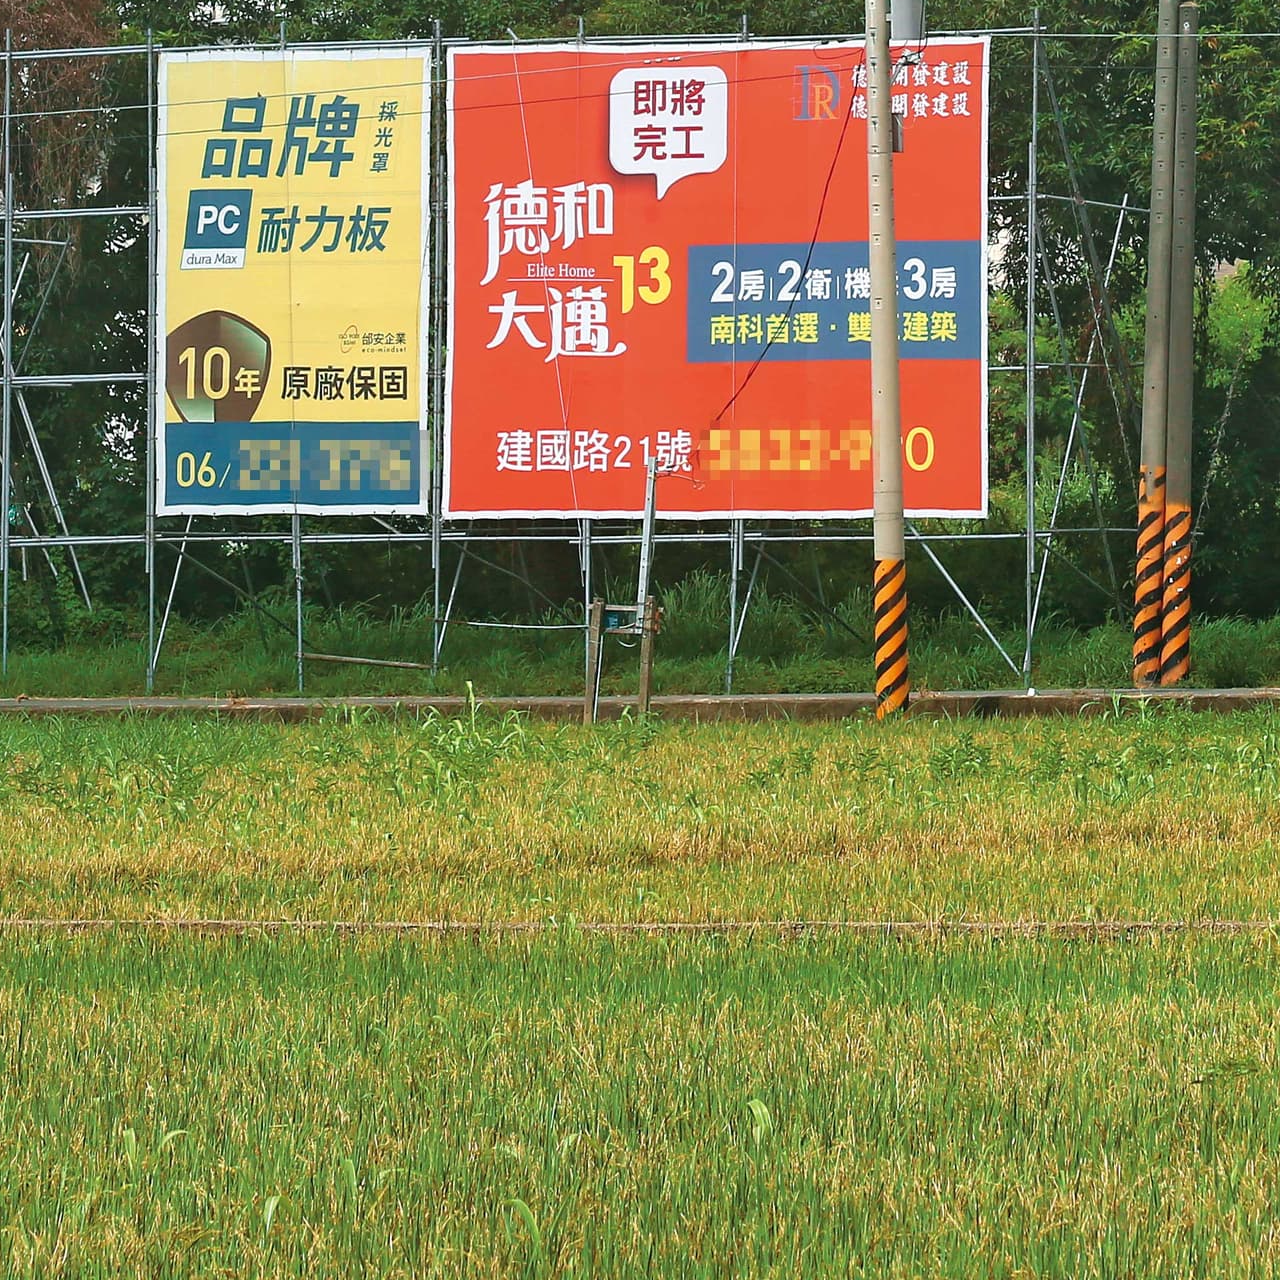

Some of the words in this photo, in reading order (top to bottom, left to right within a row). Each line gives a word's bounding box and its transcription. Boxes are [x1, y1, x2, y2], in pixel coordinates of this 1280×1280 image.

[632, 78, 706, 116] 即將
[851, 91, 972, 119] 德開發建設
[201, 95, 360, 179] 品牌
[369, 101, 398, 173] 採光罩
[632, 124, 705, 161] 完工
[196, 204, 241, 235] PC
[256, 205, 392, 253] 耐力板
[479, 179, 614, 286] 德和
[186, 253, 212, 265] dura
[214, 253, 238, 265] Max
[527, 264, 555, 277] Elite
[558, 264, 596, 278] Home
[612, 246, 672, 314] 13
[178, 347, 261, 400] 10年
[281, 366, 408, 401] 原廠保固
[496, 429, 692, 473] 建國路21號
